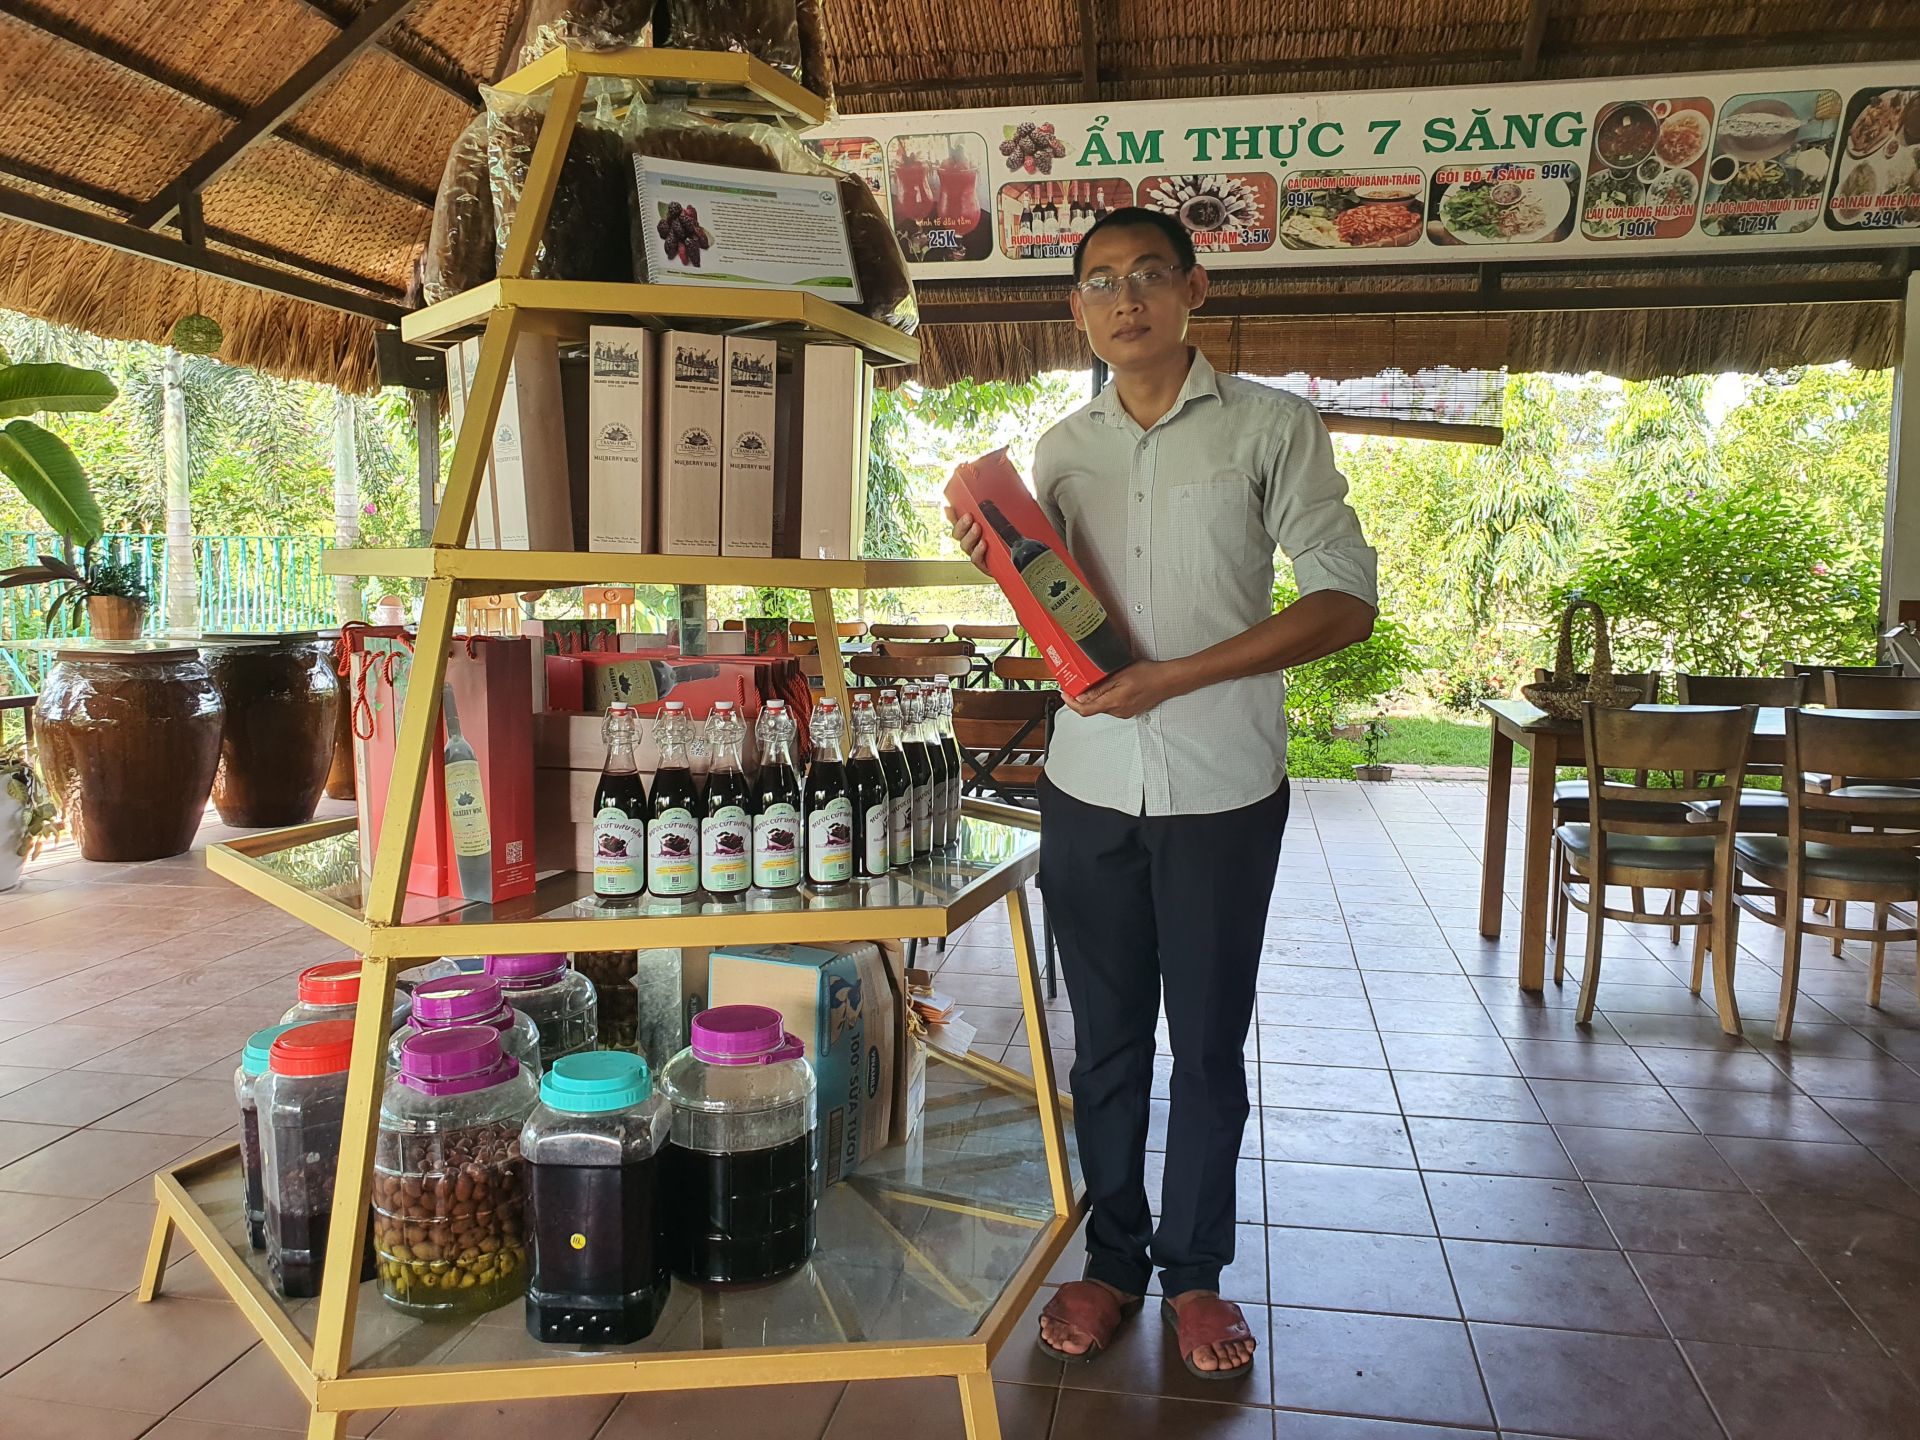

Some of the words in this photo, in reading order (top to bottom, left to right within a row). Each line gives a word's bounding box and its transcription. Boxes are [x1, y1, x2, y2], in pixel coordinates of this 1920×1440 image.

[1076, 116, 1164, 167] ẨM
[1185, 117, 1344, 168] THỰC
[1367, 120, 1401, 155] 7
[1422, 108, 1588, 154] SĂNG
[1486, 170, 1494, 181] 7
[1498, 165, 1535, 181] SĂNG
[1541, 163, 1570, 179] 99K
[1288, 191, 1314, 207] 99K
[1606, 206, 1623, 218] CUA
[1862, 210, 1903, 226] 349K
[1618, 221, 1657, 236] 190K
[1740, 216, 1778, 231] 179K
[929, 230, 956, 247] 25K
[1242, 229, 1269, 244] 3.5K
[848, 1075, 861, 1114] SỮA
